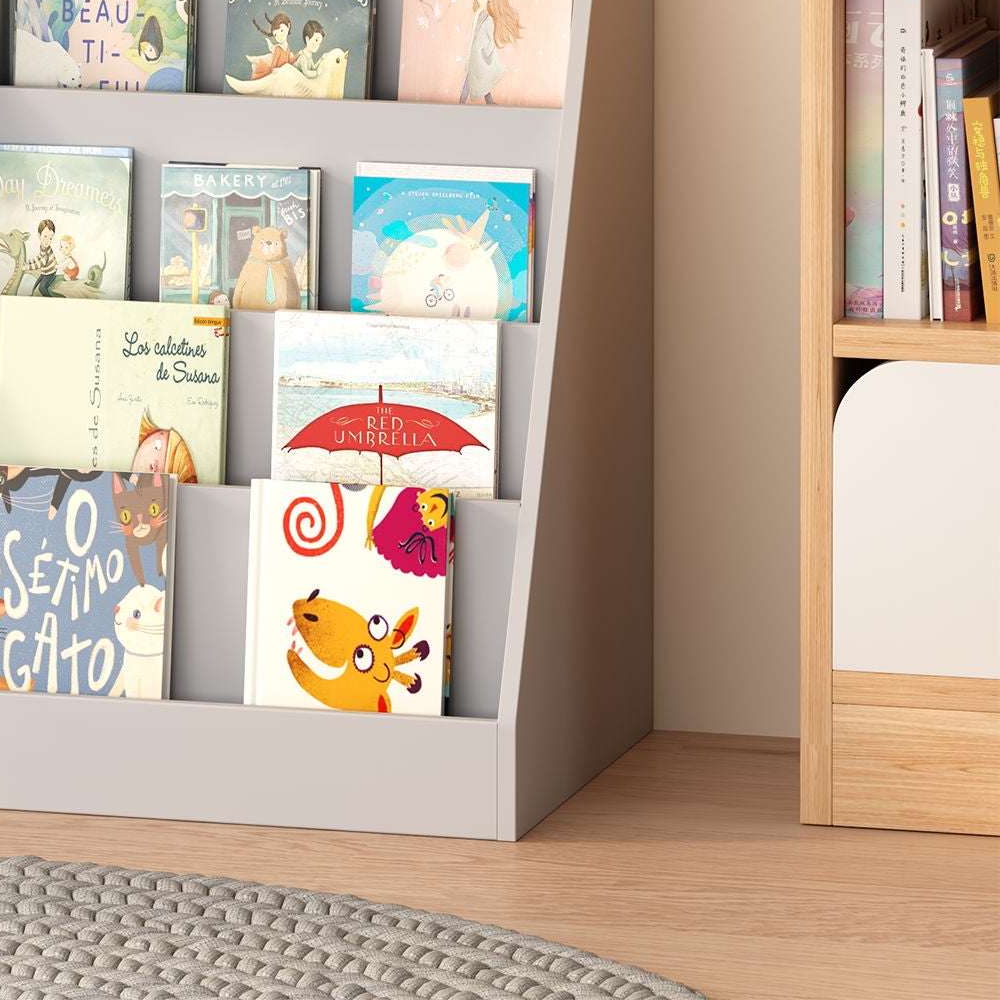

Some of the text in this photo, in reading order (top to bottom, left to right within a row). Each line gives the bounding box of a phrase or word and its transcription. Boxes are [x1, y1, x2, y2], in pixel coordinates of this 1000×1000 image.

[82, 39, 121, 64] TI-
[33, 160, 123, 215] Dreamers
[193, 174, 267, 188] BAKERY
[122, 331, 207, 358] Los calcetines
[88, 328, 102, 409] Susana
[156, 360, 221, 384] de Susana
[376, 406, 393, 415] THE
[88, 415, 99, 440] de
[367, 416, 404, 431] RED
[334, 430, 437, 447] UMBRELLA
[65, 488, 98, 557] O
[3, 529, 125, 621] SÉTIMO
[3, 611, 116, 695] GATO
